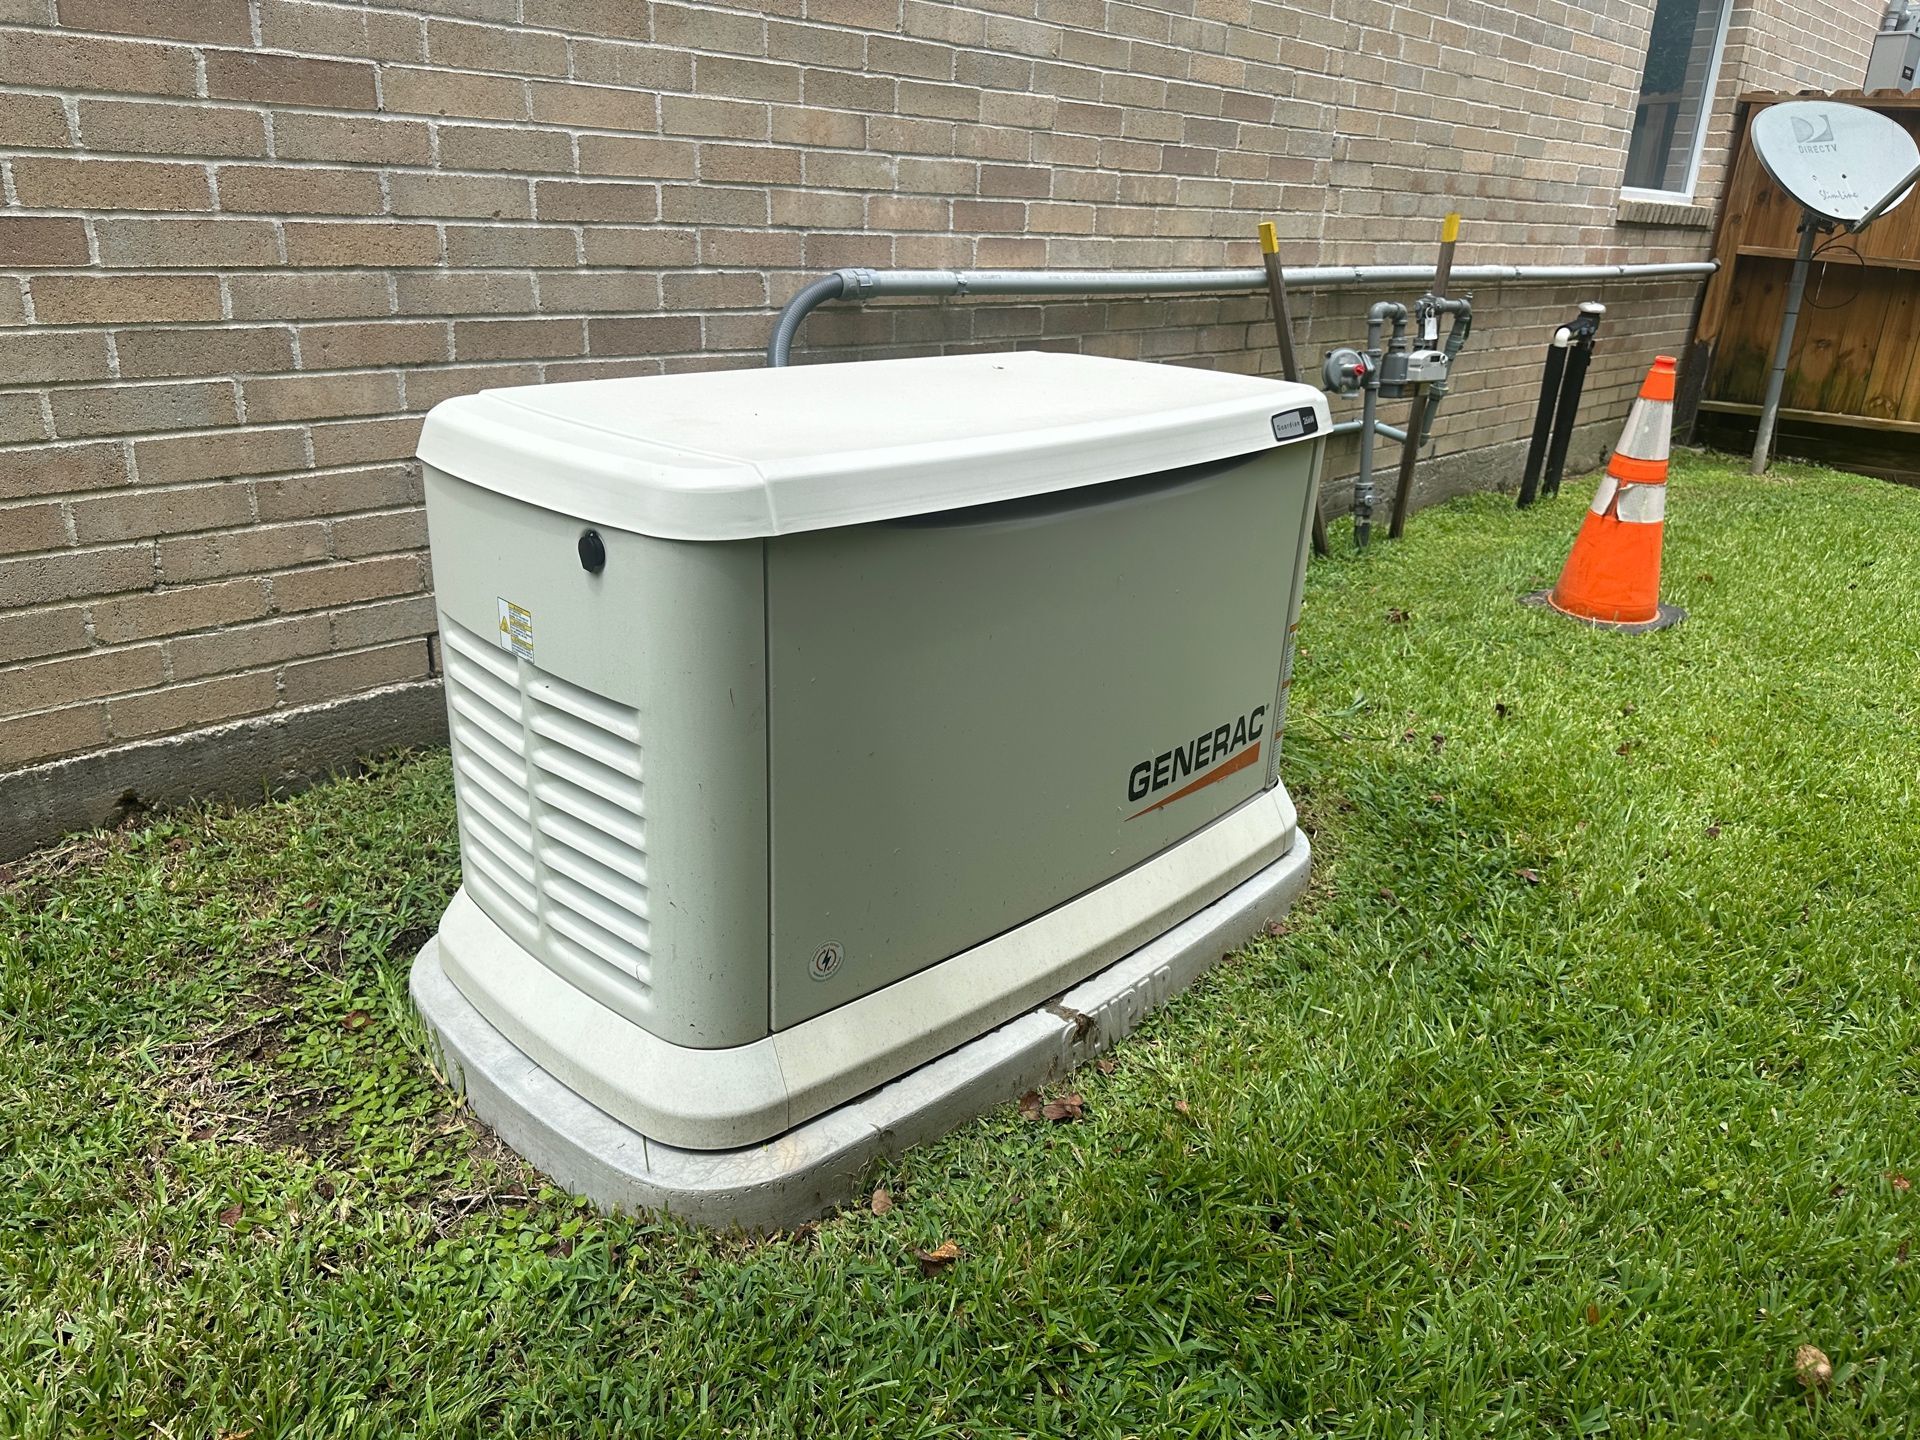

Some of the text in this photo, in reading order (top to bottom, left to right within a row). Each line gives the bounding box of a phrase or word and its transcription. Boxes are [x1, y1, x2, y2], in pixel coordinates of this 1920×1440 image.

[1798, 144, 1838, 154] DIRECTV
[1276, 421, 1300, 432] Guardian
[1128, 705, 1265, 802] GENERAC
